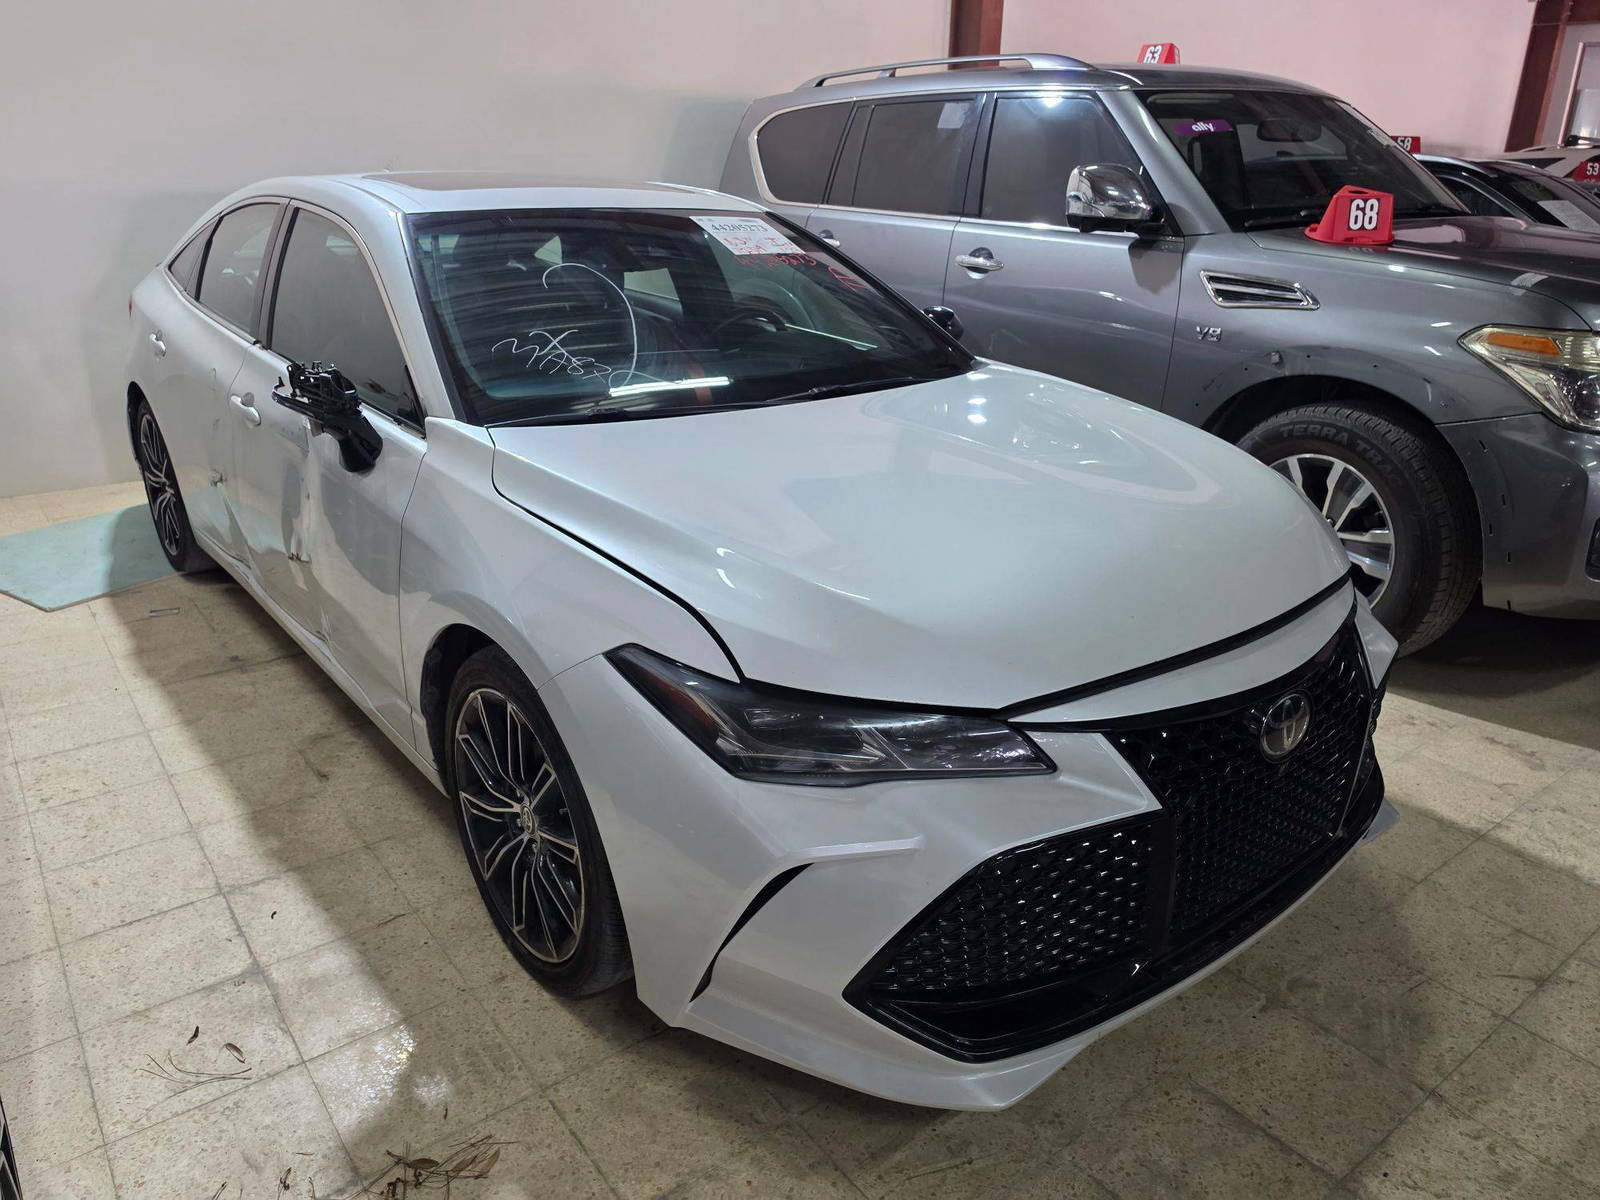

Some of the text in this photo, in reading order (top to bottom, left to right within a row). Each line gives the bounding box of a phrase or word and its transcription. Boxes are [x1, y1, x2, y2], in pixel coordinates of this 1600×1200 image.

[1143, 44, 1162, 64] 63
[1191, 121, 1215, 132] ally
[1586, 162, 1600, 176] 53
[1348, 198, 1379, 230] 68
[1196, 326, 1222, 342] V8
[1279, 423, 1349, 445] TERRA
